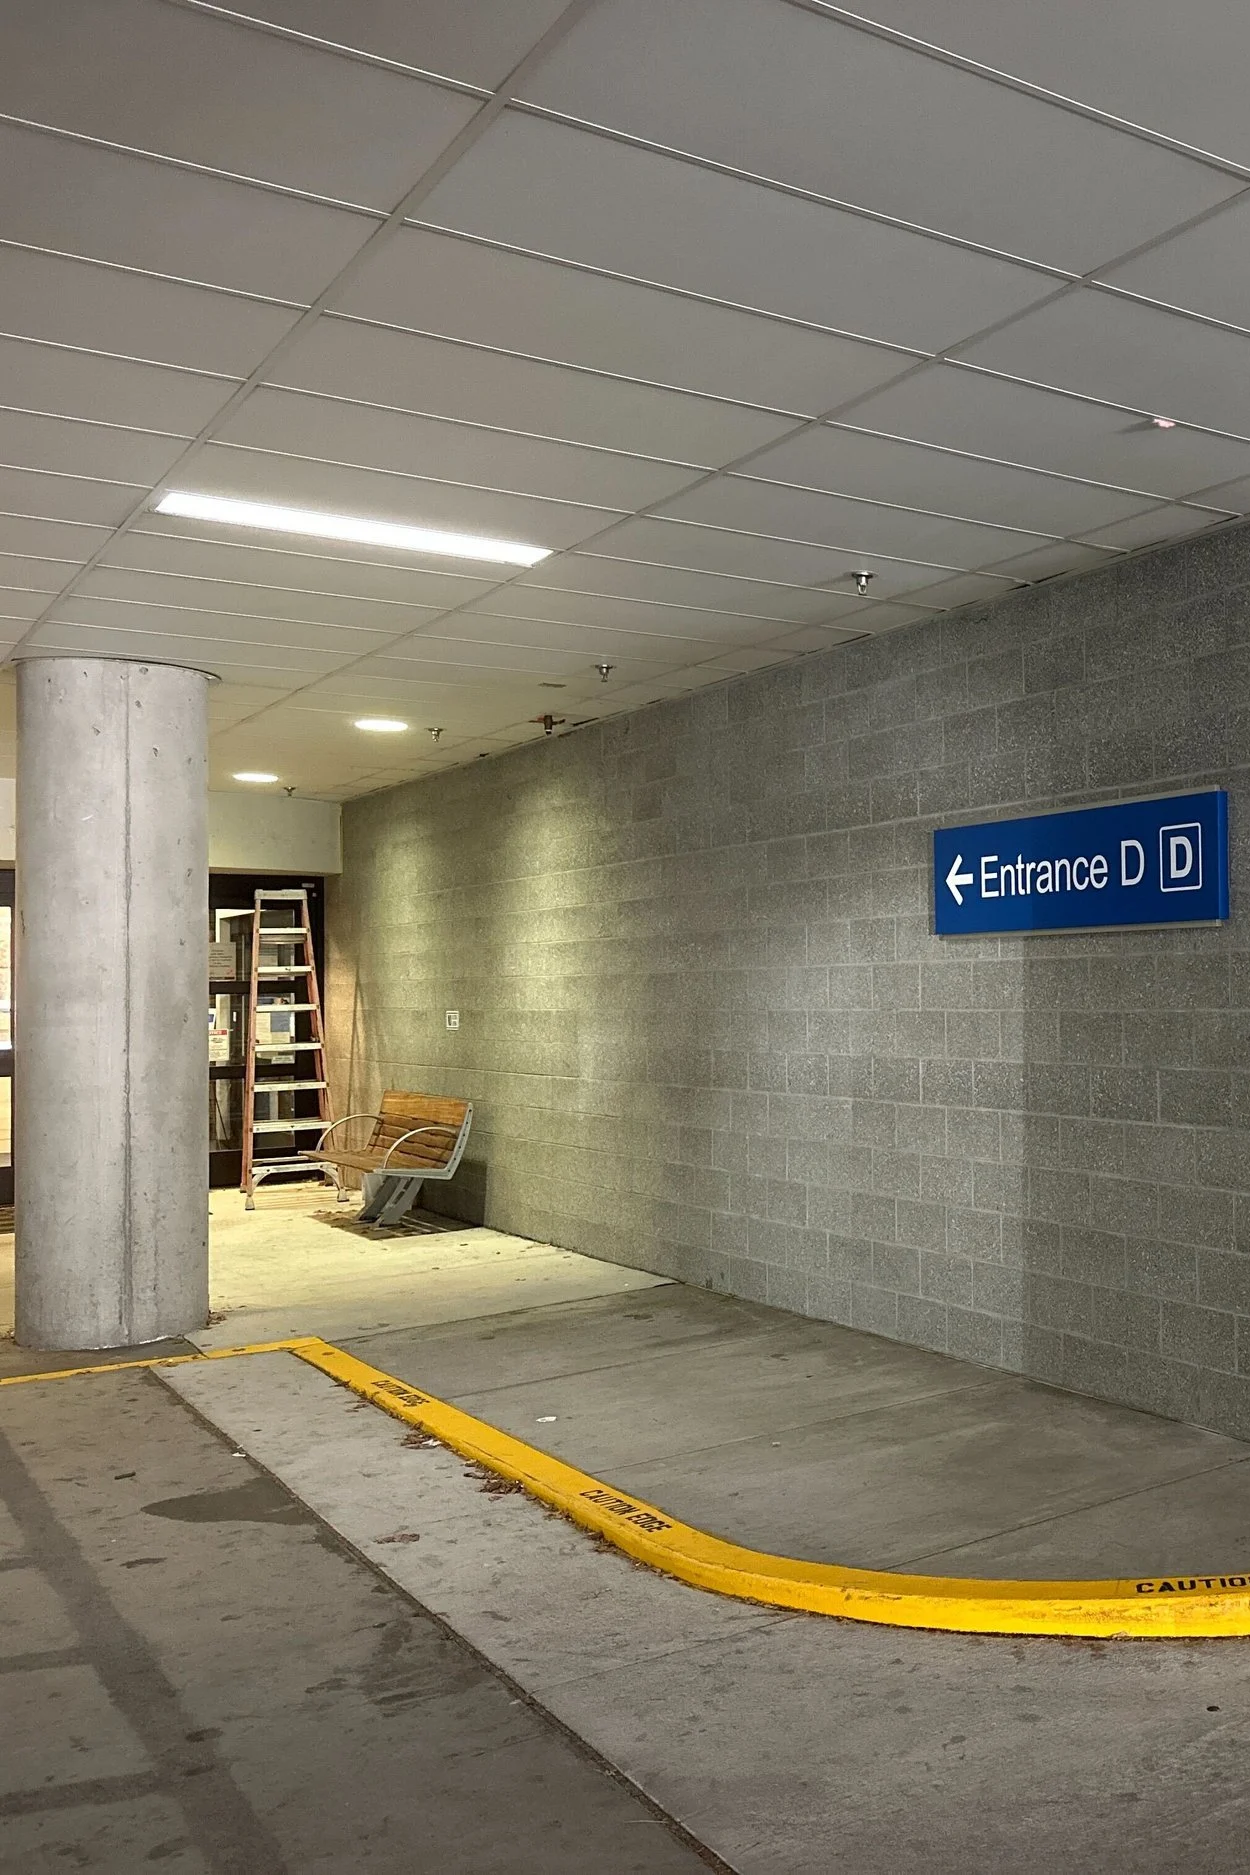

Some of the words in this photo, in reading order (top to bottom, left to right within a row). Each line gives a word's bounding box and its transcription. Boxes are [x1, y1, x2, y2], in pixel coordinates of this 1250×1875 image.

[980, 853, 1108, 898] Entrance
[1121, 839, 1145, 886] D
[1169, 836, 1194, 879] D
[579, 1489, 641, 1516] CAUTION
[625, 1512, 673, 1533] EDGE
